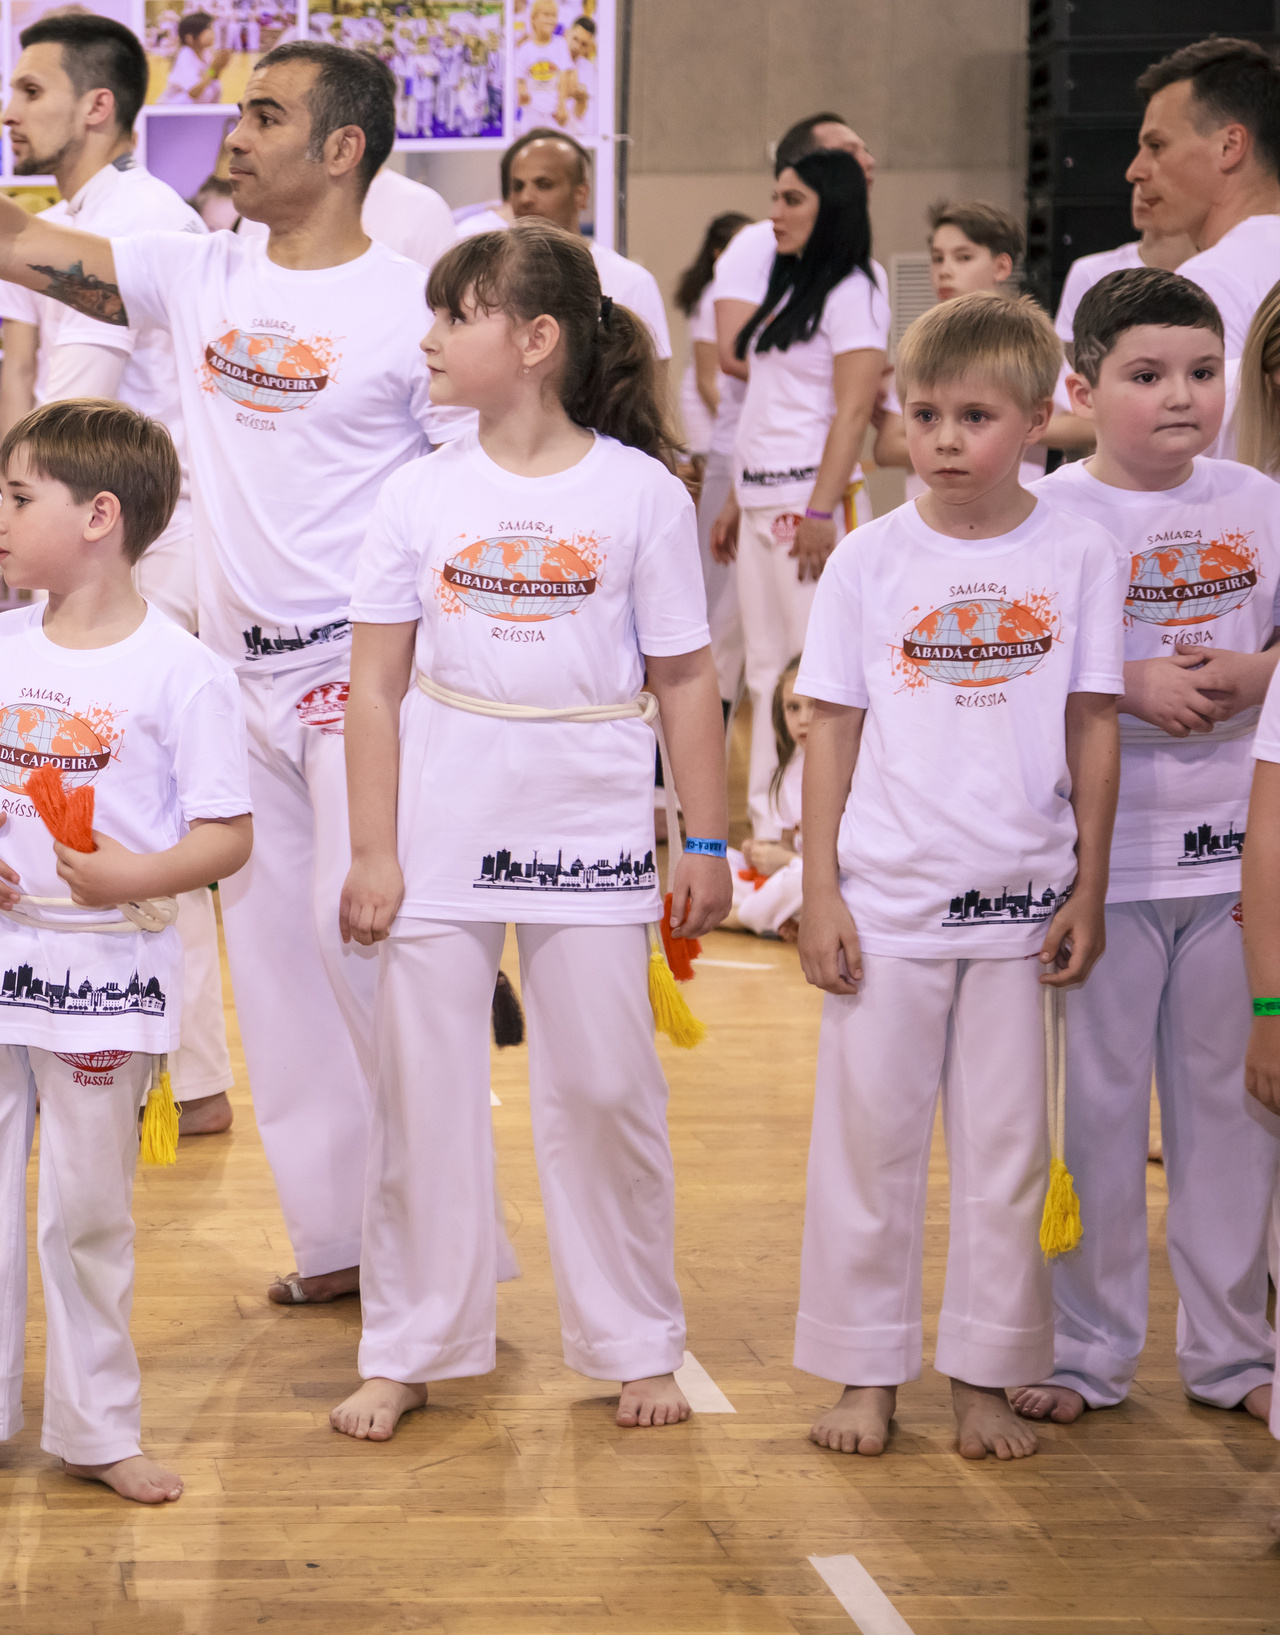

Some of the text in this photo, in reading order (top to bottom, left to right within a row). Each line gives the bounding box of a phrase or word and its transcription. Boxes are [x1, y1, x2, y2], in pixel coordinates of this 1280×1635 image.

[250, 319, 296, 333] SAMARA
[208, 355, 318, 390] ABADÁ-CAPOEIRA
[235, 412, 276, 431] RÚSSIA
[498, 520, 553, 534] SAMARA
[1147, 529, 1203, 545] SAMARA
[450, 572, 587, 594] ABADÁ-CAPOEIRA
[949, 582, 1007, 597] SAMARA
[1128, 575, 1252, 600] BADÁ-CAPOEIRA
[491, 625, 545, 643] RÚSSIA
[1161, 628, 1214, 646] RÚSSIA
[911, 641, 1044, 659] ABADÁ-CAPOEIRA
[19, 687, 71, 706] SAMARA
[955, 690, 1007, 708] RÚSSIA
[1, 798, 42, 817] RÚSSI
[72, 1070, 115, 1087] Russia
